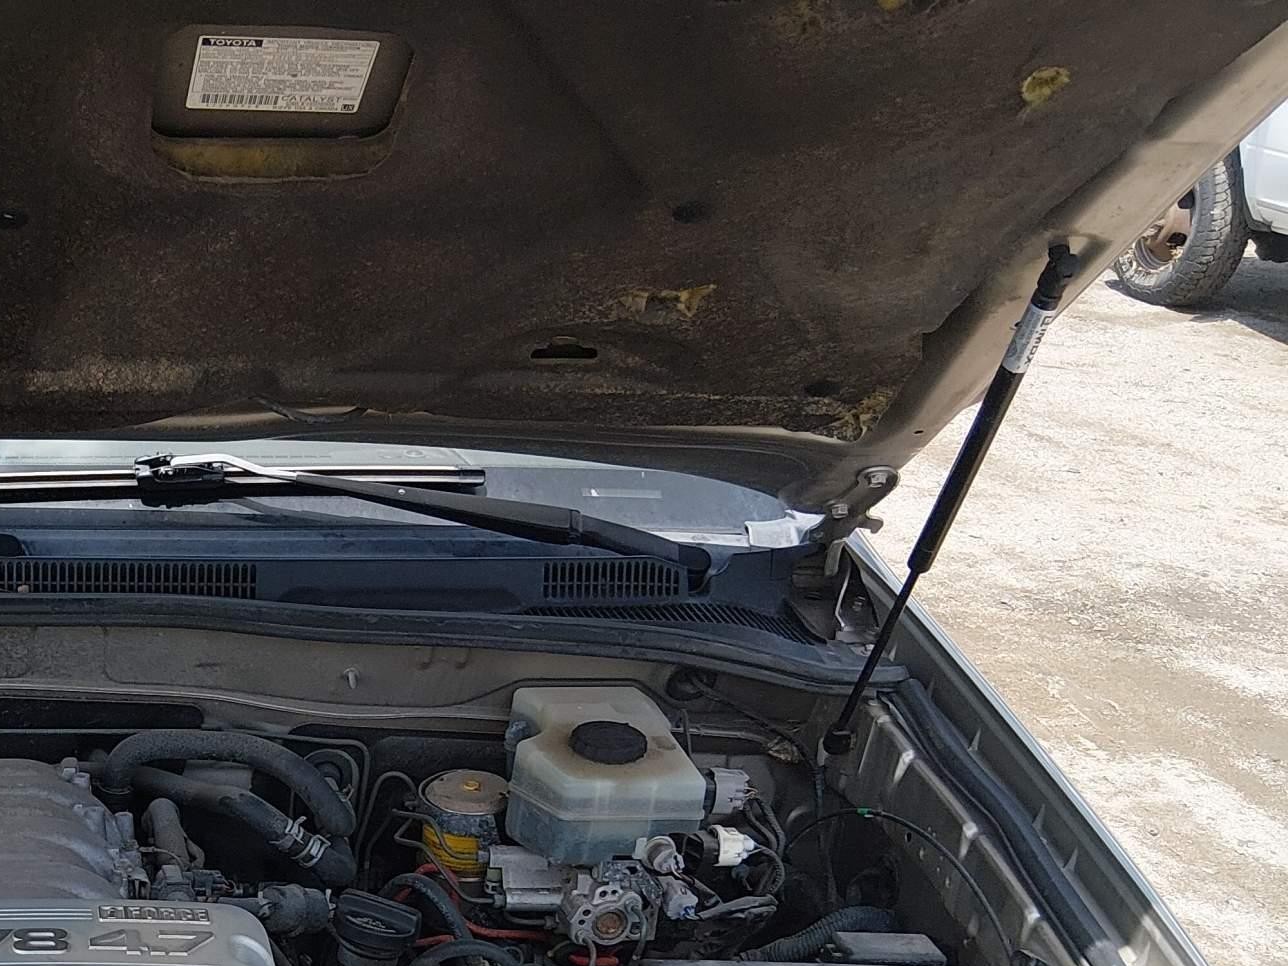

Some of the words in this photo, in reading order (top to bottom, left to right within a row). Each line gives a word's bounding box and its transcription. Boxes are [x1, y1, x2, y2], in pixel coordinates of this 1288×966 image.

[208, 38, 257, 47] TOYOTA
[281, 95, 343, 103] CATALYST
[88, 929, 215, 956] 4.7
